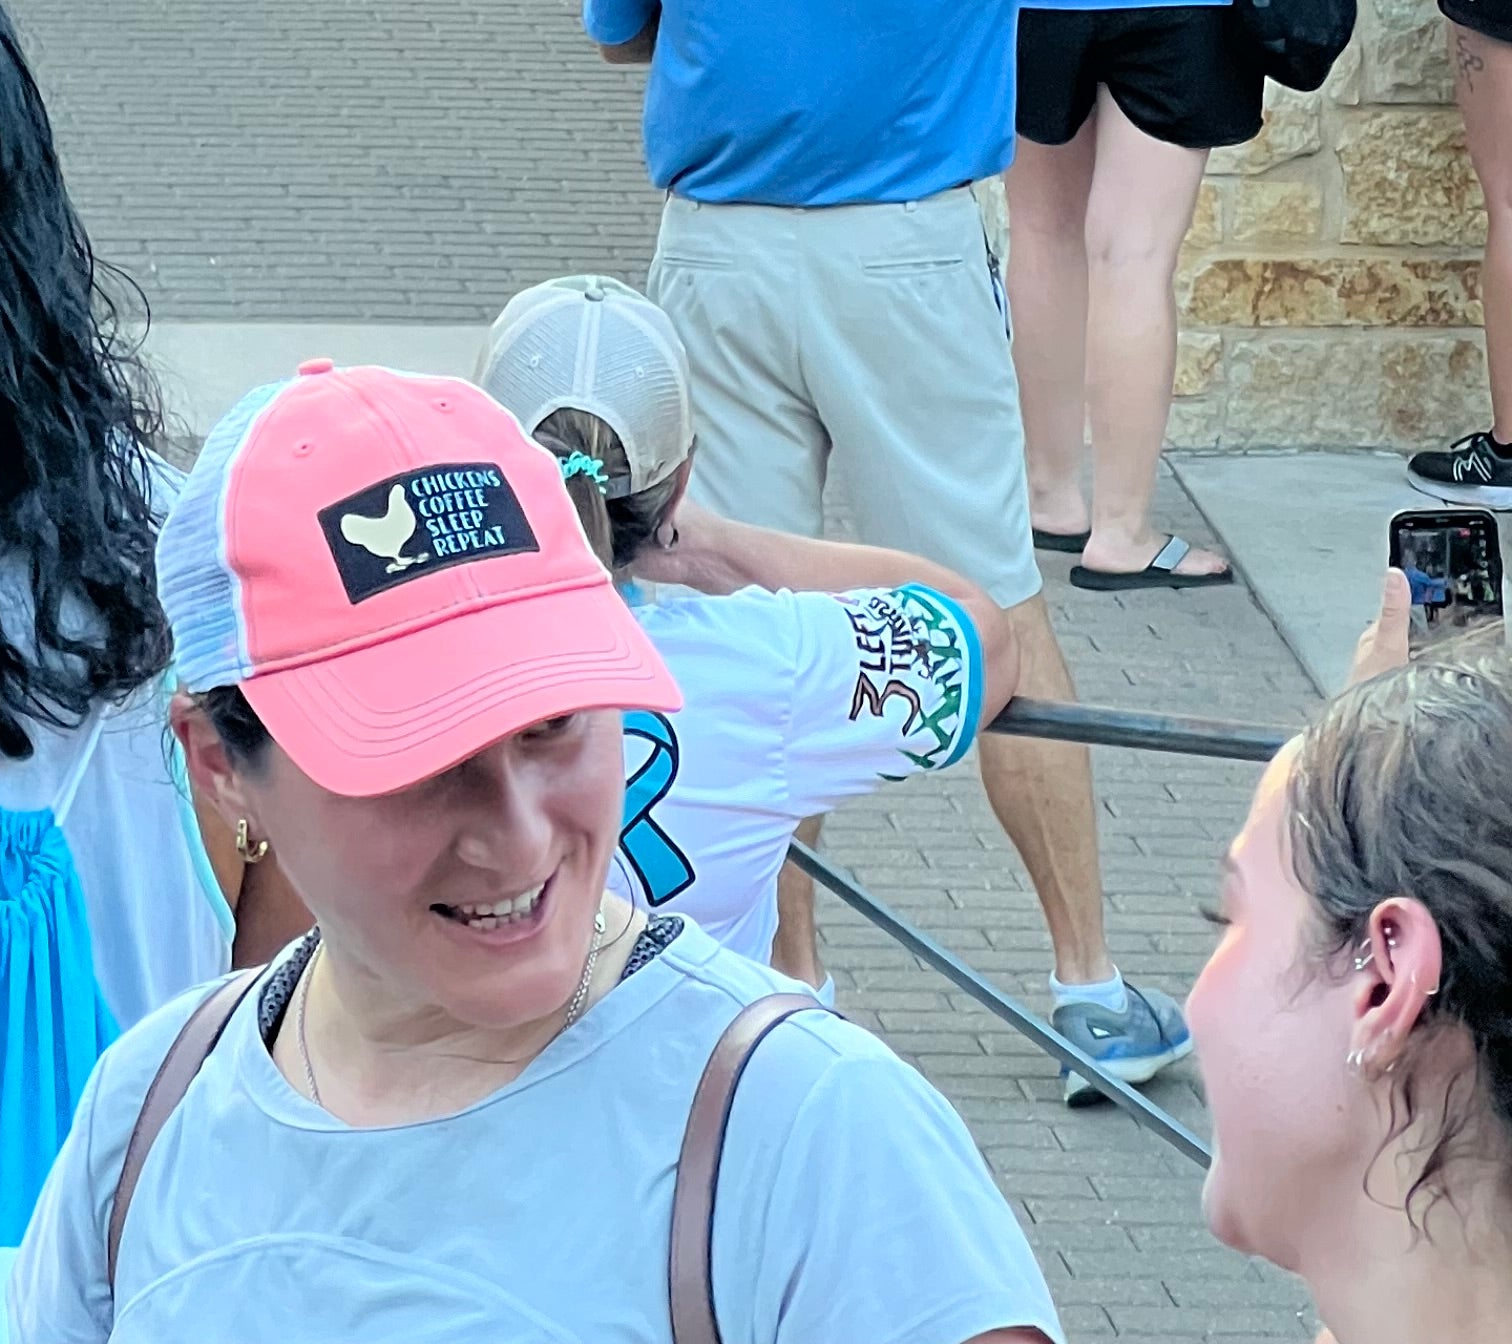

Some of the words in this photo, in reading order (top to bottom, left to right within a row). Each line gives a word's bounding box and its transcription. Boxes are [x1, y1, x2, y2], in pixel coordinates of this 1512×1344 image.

[410, 469, 502, 498] CHICKENS
[418, 487, 489, 518] COFFEE
[425, 509, 484, 538] SLEEP
[432, 525, 506, 558] REPEAT
